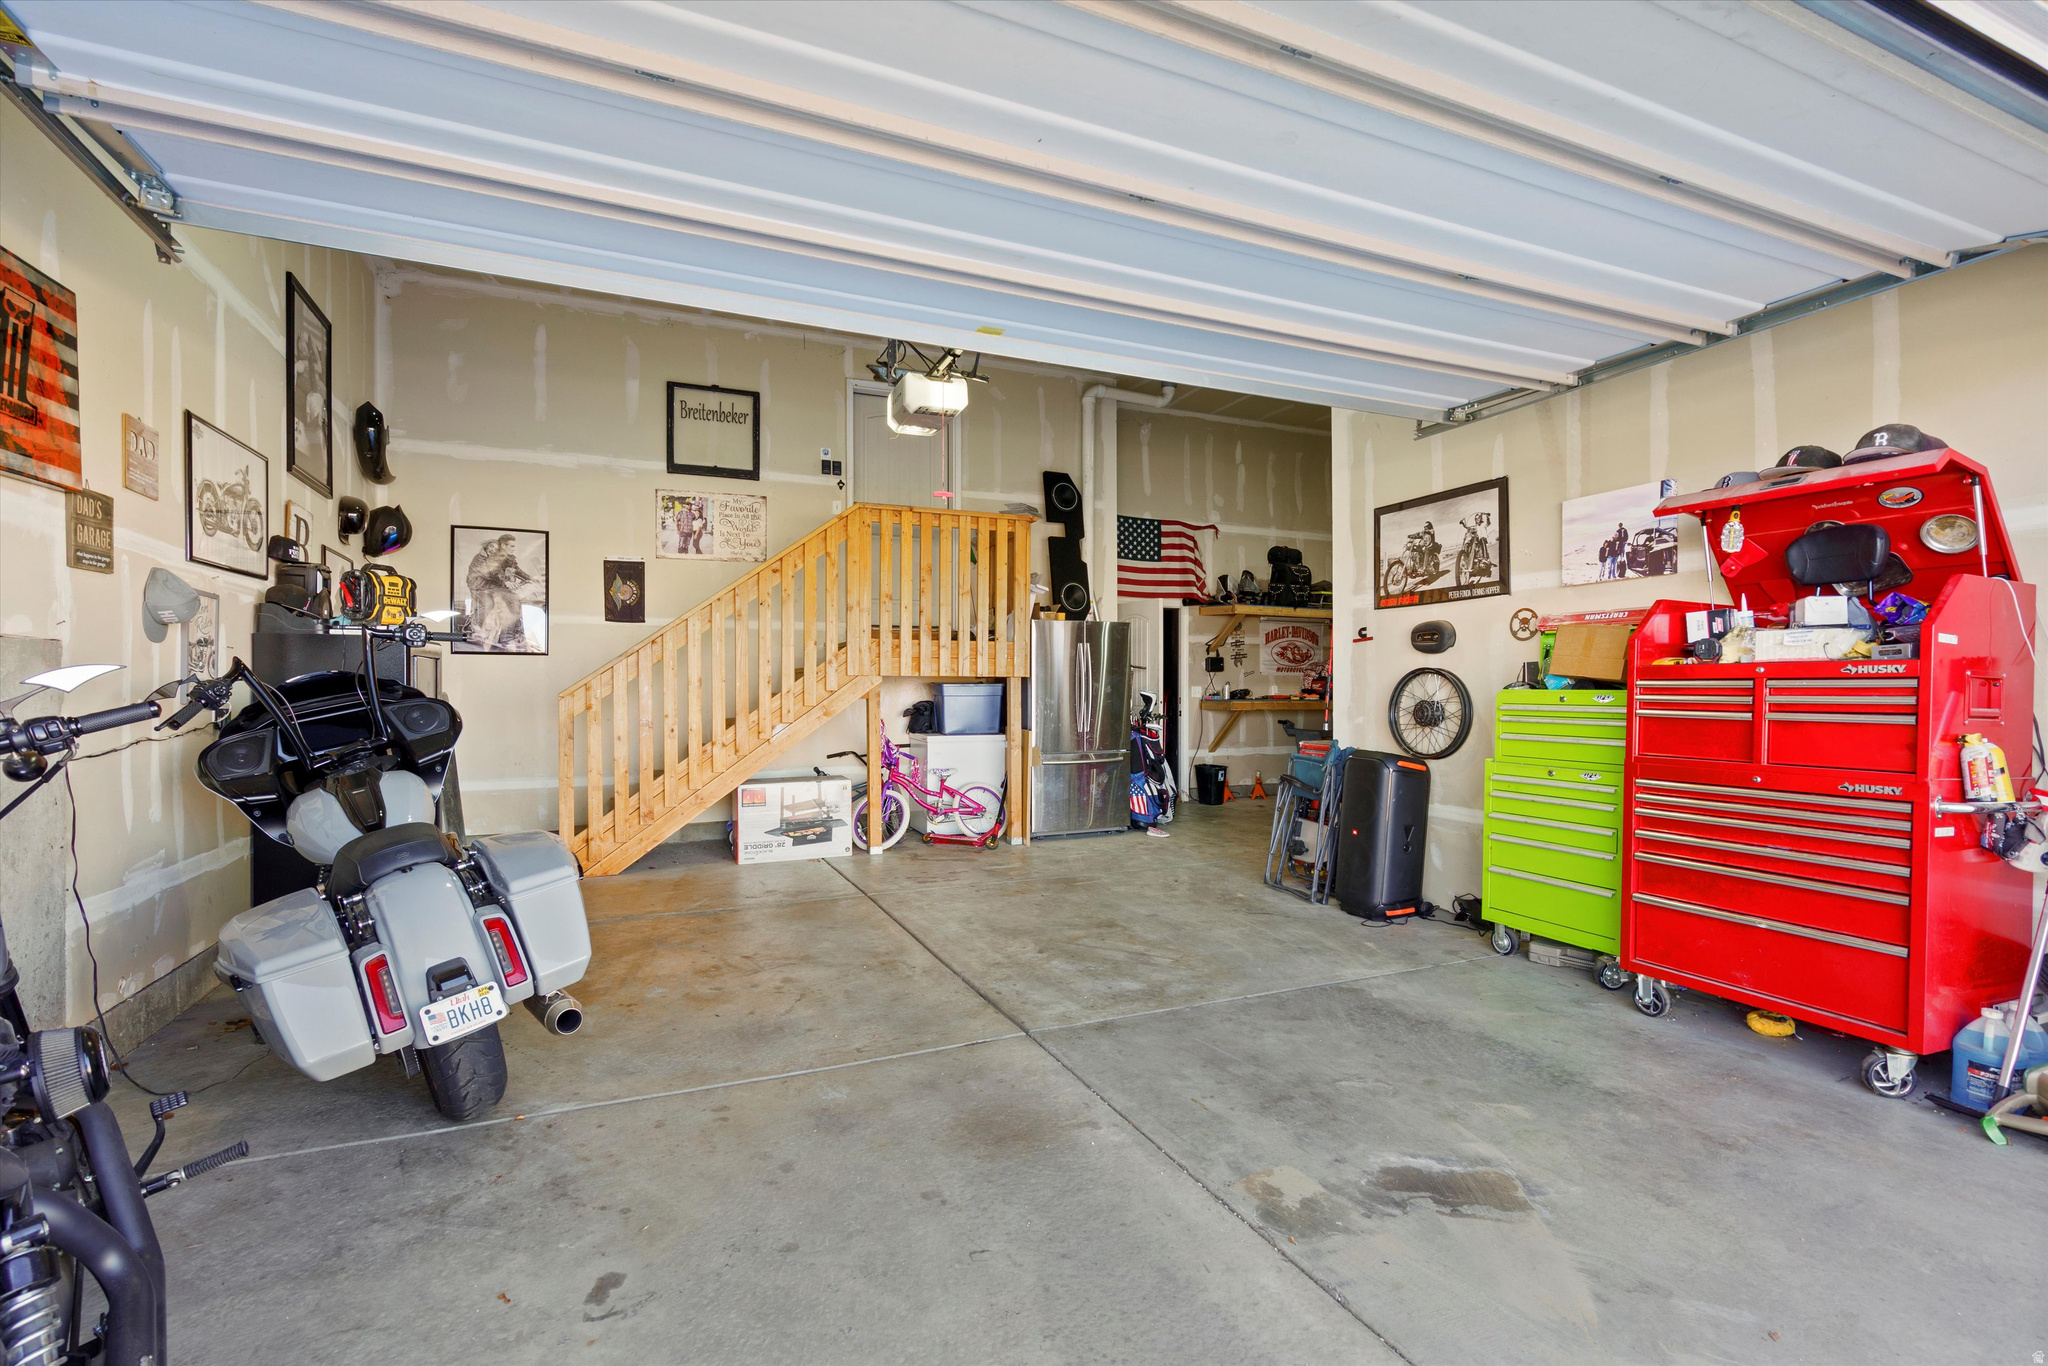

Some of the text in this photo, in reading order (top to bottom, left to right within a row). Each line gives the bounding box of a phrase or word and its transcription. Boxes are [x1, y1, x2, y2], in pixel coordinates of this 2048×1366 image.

[680, 400, 749, 424] Breitenbeker
[130, 430, 155, 460] DAD
[77, 495, 102, 519] DAD'S
[719, 500, 761, 513] Favorite
[719, 518, 758, 532] World
[77, 524, 110, 549] GARAGE
[733, 538, 761, 550] You
[1449, 586, 1500, 599] PETER FONDA DENNIS HOPPER
[1584, 611, 1628, 620] CRAFTSMAN
[1857, 664, 1907, 674] HUSKY
[1854, 784, 1903, 796] HUSKY
[450, 993, 470, 1006] Utah
[1980, 1071, 2000, 1080] POWE
